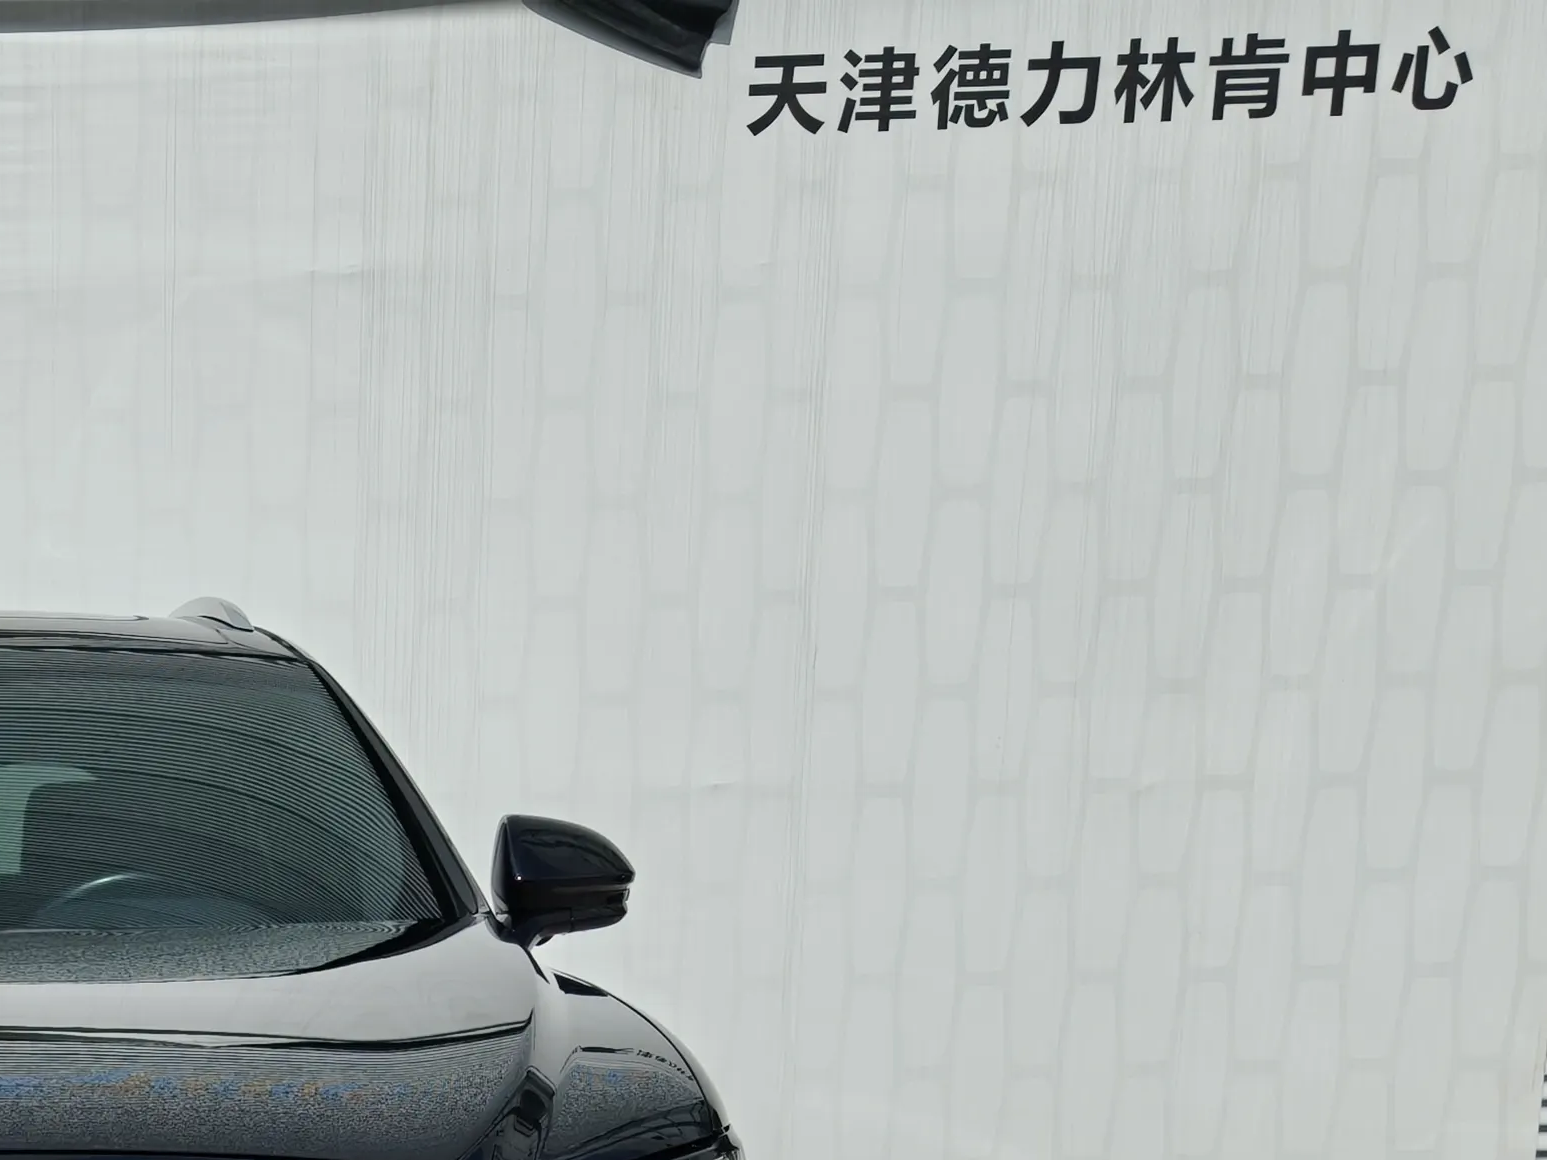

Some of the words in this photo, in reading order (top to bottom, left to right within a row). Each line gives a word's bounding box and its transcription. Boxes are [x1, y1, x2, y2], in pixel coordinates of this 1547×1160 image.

[746, 25, 1474, 137] 天津德力林肯中心
